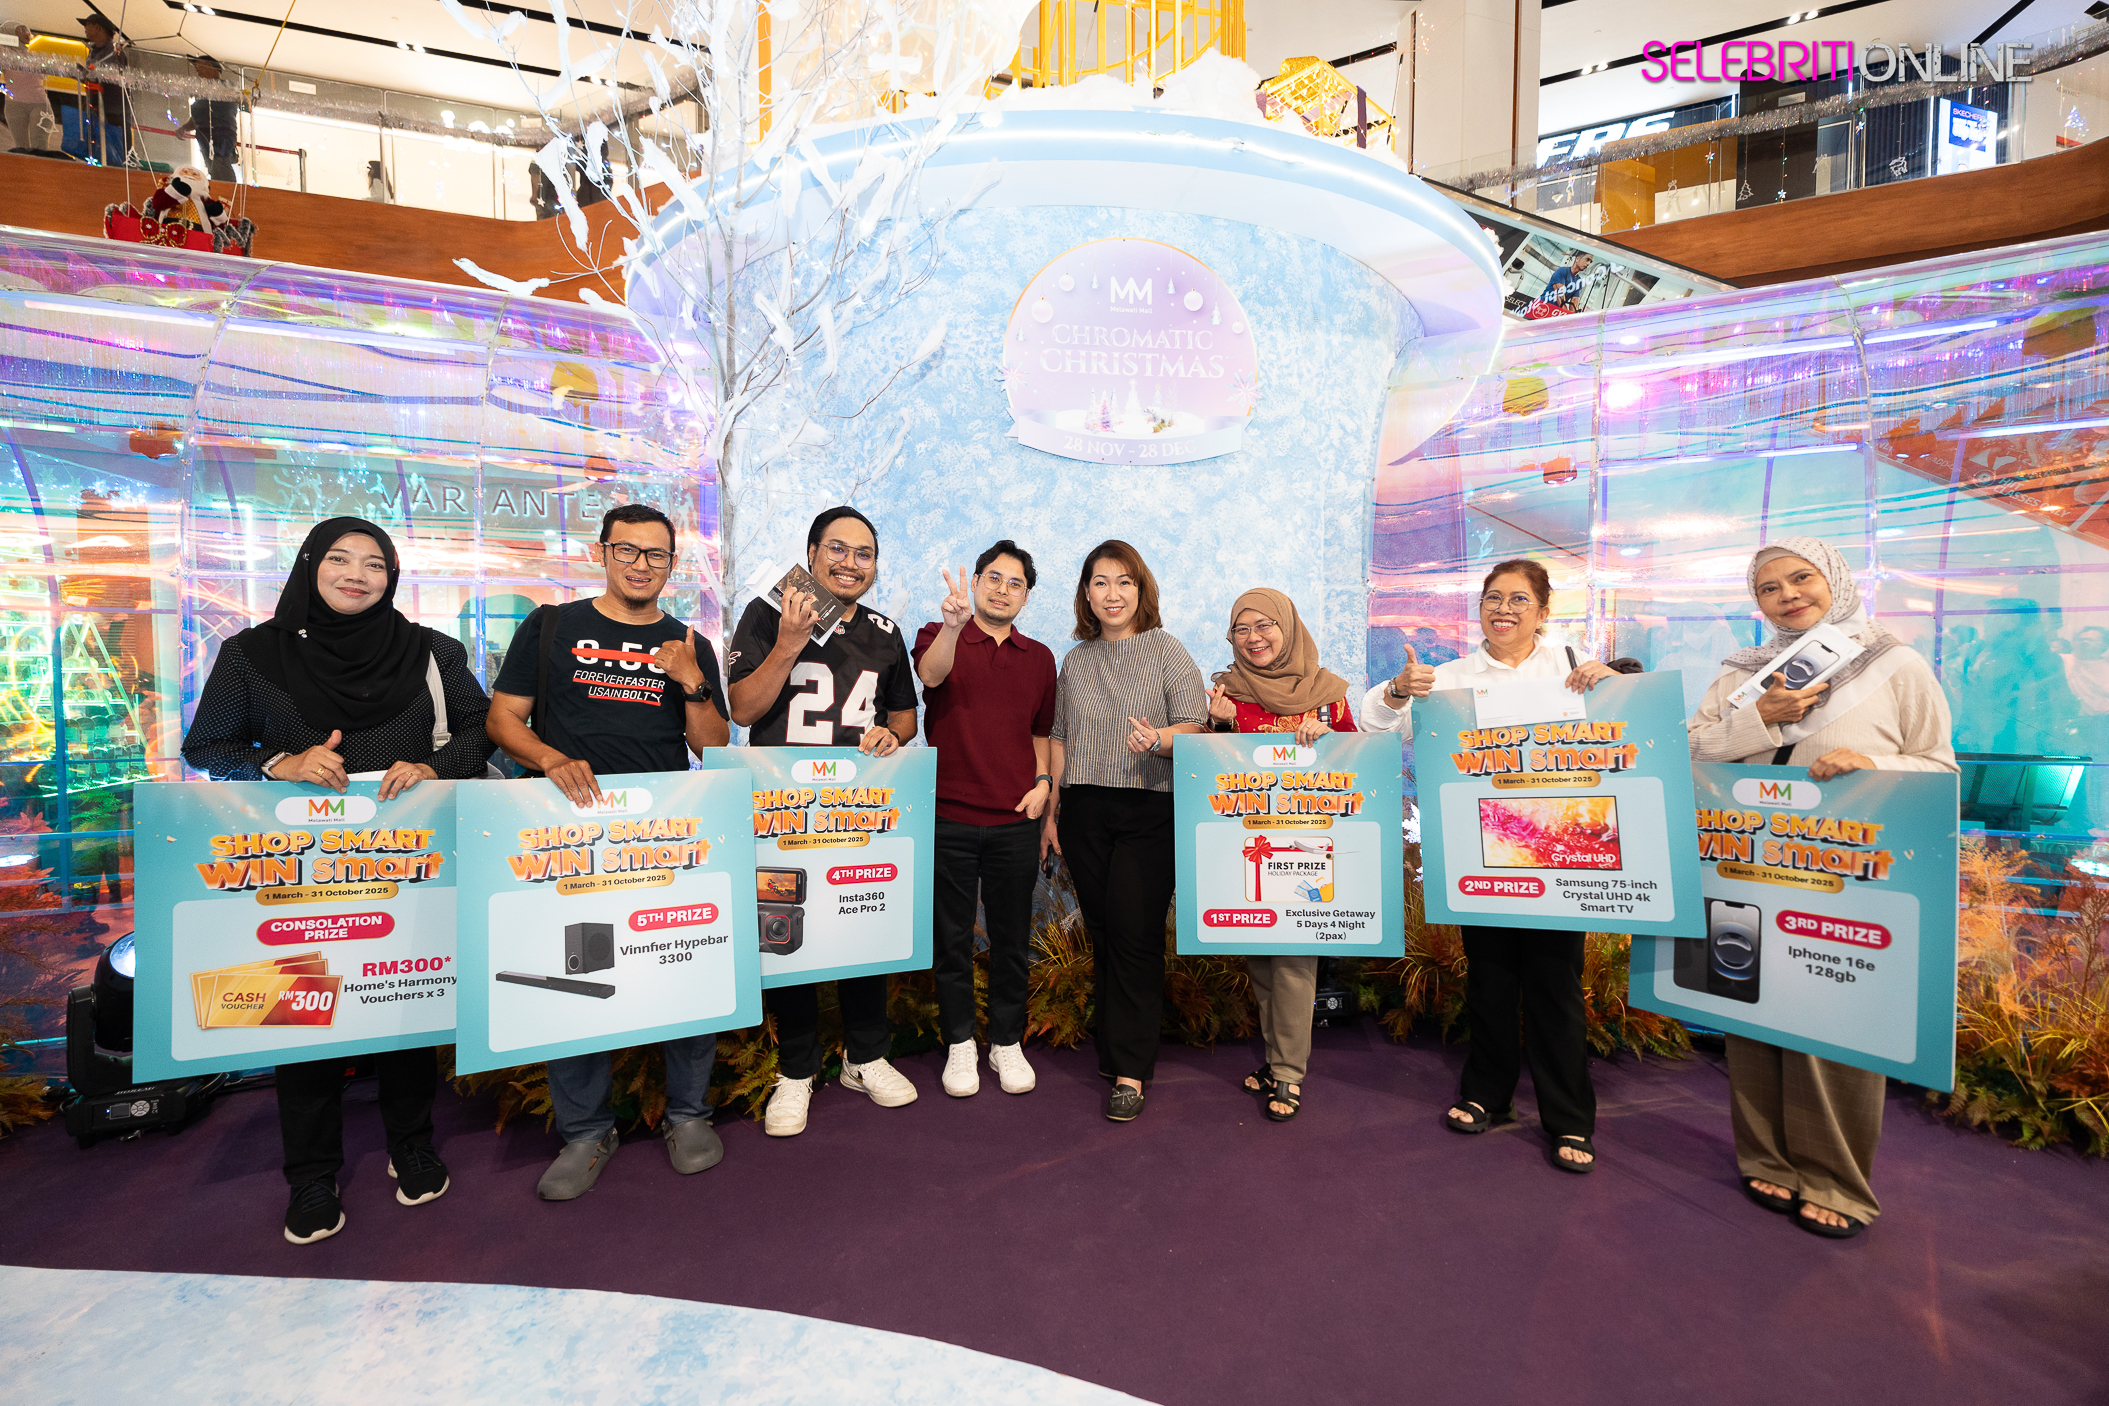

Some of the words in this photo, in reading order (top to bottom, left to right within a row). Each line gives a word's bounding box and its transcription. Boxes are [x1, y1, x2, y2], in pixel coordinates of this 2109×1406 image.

[1110, 276, 1152, 305] MM
[1110, 305, 1138, 314] Melawati
[1139, 306, 1153, 314] Mall
[1052, 323, 1213, 350] CHROMATIC
[1040, 348, 1225, 378] CHRISTMAS
[1063, 435, 1083, 451] 28
[1087, 440, 1126, 457] NOV
[1138, 443, 1158, 458] 28
[1161, 440, 1197, 457] DEC
[1993, 485, 2041, 509] CLASSES
[573, 670, 666, 690] FOREVERFASTER
[588, 686, 651, 701] USAINBOLT
[786, 661, 879, 745] 24
[1458, 725, 1528, 749] SHOP
[1534, 721, 1628, 745] SMART
[1451, 748, 1522, 776] WIN
[1530, 742, 1639, 772] smart
[1215, 772, 1277, 791] SHOP
[1281, 771, 1358, 790] SMART
[1503, 777, 1525, 785] March
[1541, 776, 1571, 784] October
[820, 786, 895, 807] SMART
[1208, 792, 1269, 816] WIN
[1276, 791, 1365, 815] smart
[813, 807, 901, 832] smart
[1769, 811, 1883, 845] SMART
[209, 830, 314, 857] SHOP
[321, 829, 435, 852] SMART
[518, 821, 602, 849] SHOP
[608, 818, 701, 841] SMART
[822, 836, 847, 844] October
[507, 847, 593, 881] WIN
[602, 839, 711, 871] smart
[1267, 862, 1294, 870] FIRST
[1297, 862, 1326, 870] PRIZE
[1551, 852, 1592, 863] Crystal
[1592, 853, 1616, 863] UHD
[1762, 838, 1895, 880] smart
[195, 857, 301, 890] WIN
[312, 851, 445, 883] smart
[832, 869, 853, 881] 4TH
[855, 867, 892, 880] PRIZE
[1729, 867, 1754, 877] March
[1762, 871, 1772, 879] 31
[1774, 872, 1809, 885] October
[1810, 878, 1834, 887] 2025
[570, 881, 596, 889] March
[602, 879, 612, 887] 31
[613, 876, 645, 885] October
[646, 874, 667, 882] 2025
[1464, 880, 1491, 892] 2ND
[1493, 881, 1539, 894] PRIZE
[1555, 878, 1609, 890] Samsung
[1611, 879, 1657, 890] 75-inch
[272, 891, 303, 900] March
[311, 890, 324, 898] 31
[325, 887, 363, 897] October
[365, 886, 389, 895] 2025
[839, 891, 885, 903] Insta360
[1562, 890, 1604, 902] Crystal
[1605, 891, 1633, 901] UHD
[1635, 892, 1651, 902] 4k
[637, 912, 664, 927] 5TH
[667, 907, 712, 923] PRIZE
[838, 906, 858, 915] Ace
[860, 904, 877, 913] Pro
[879, 903, 886, 912] 2
[1285, 909, 1331, 917] Exclusive
[1332, 909, 1375, 919] Getaway
[1580, 903, 1615, 913] Smart
[1616, 904, 1634, 914] TV
[270, 915, 382, 932] CONSOLATION
[1210, 913, 1230, 923] 1ST
[1232, 913, 1271, 924] PRIZE
[1296, 920, 1303, 928] 5
[1304, 920, 1328, 930] Days
[1330, 920, 1336, 928] 4
[1338, 920, 1365, 930] Night
[304, 928, 348, 940] PRIZE
[1315, 931, 1347, 941] (2pax)
[1784, 915, 1818, 931] 3RD
[1821, 922, 1882, 945] PRIZE
[620, 941, 672, 956] Vinnfier
[674, 934, 729, 952] Hypebar
[659, 952, 693, 965] 3300
[1788, 945, 1841, 965] Iphone
[1846, 958, 1876, 972] 16e
[1805, 963, 1856, 984] 128gb
[344, 980, 395, 993] Home's
[398, 975, 457, 989] Harmony
[222, 992, 266, 1003] CASH
[360, 990, 424, 1004] Vouchers
[436, 988, 445, 997] 3
